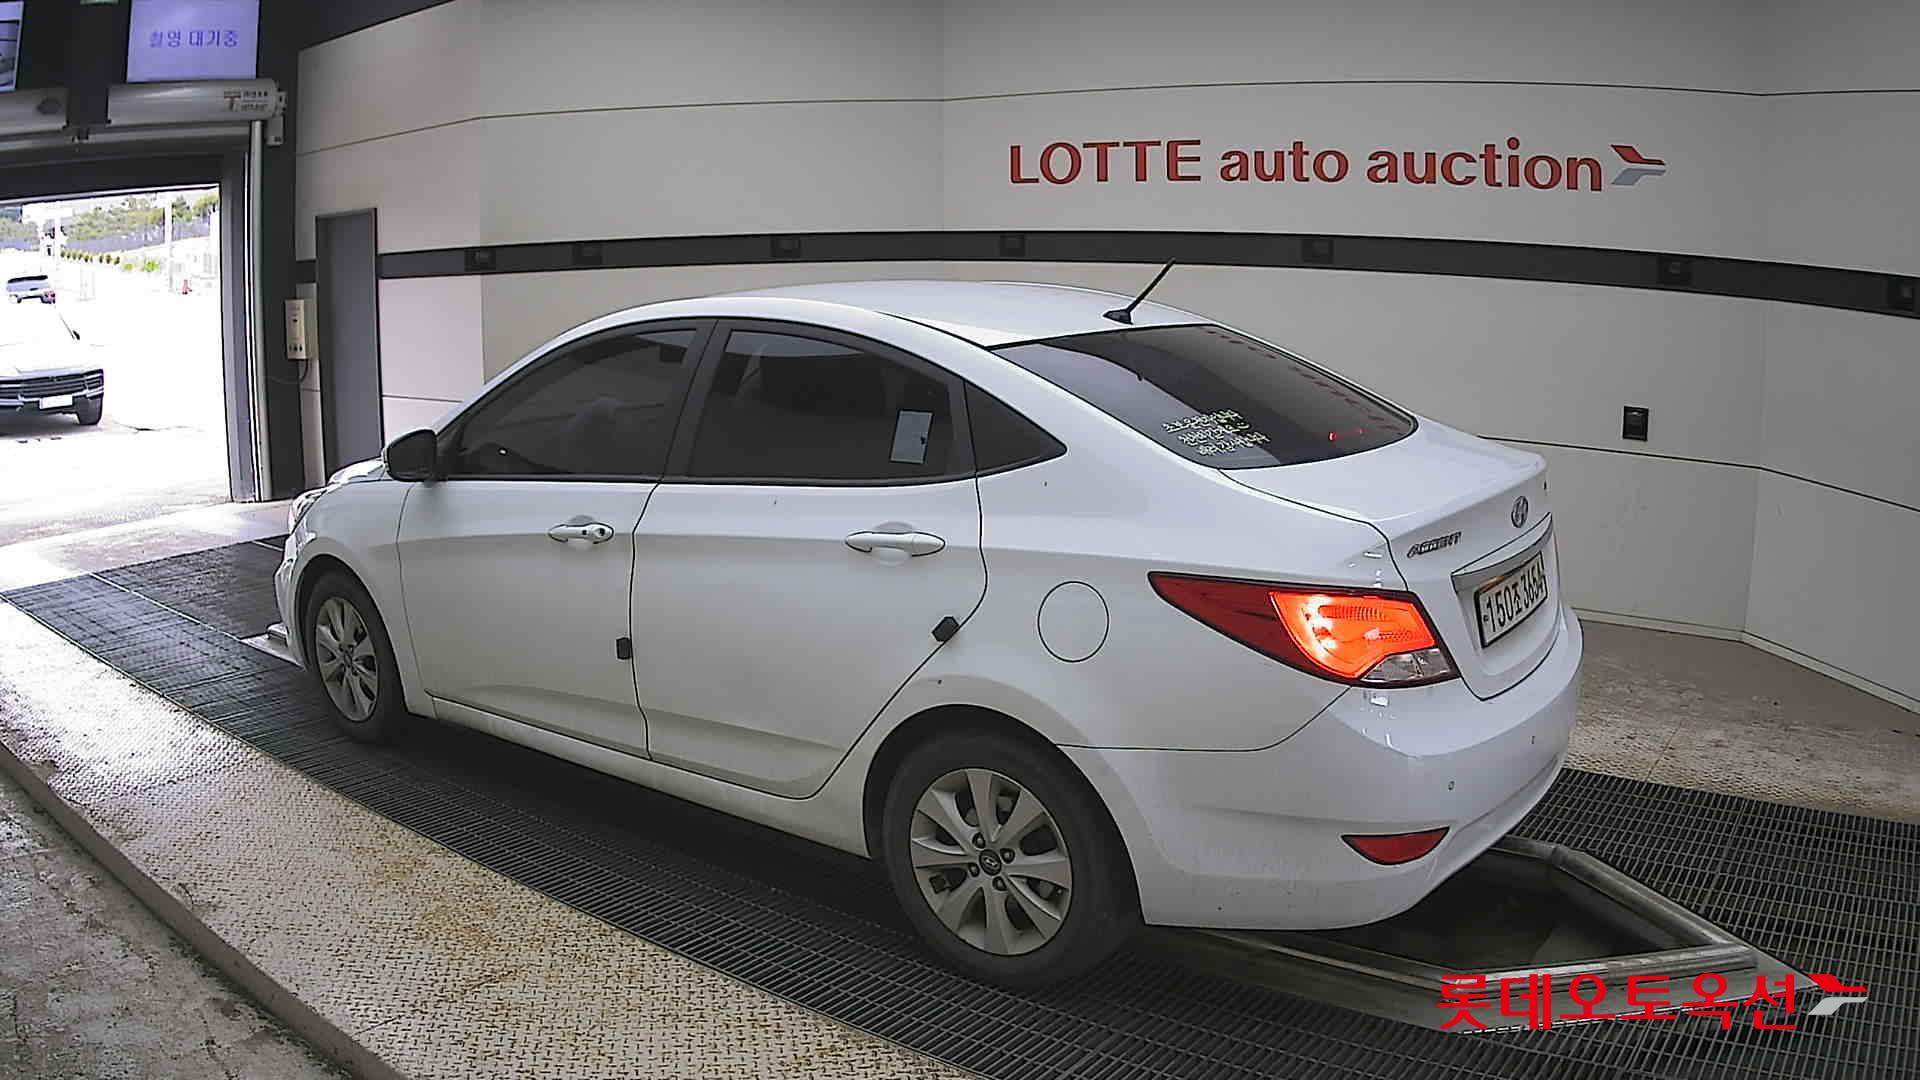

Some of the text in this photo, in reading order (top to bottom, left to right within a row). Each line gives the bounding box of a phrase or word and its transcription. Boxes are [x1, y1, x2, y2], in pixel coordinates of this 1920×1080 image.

[1009, 137, 1602, 192] LOTTE auto auction
